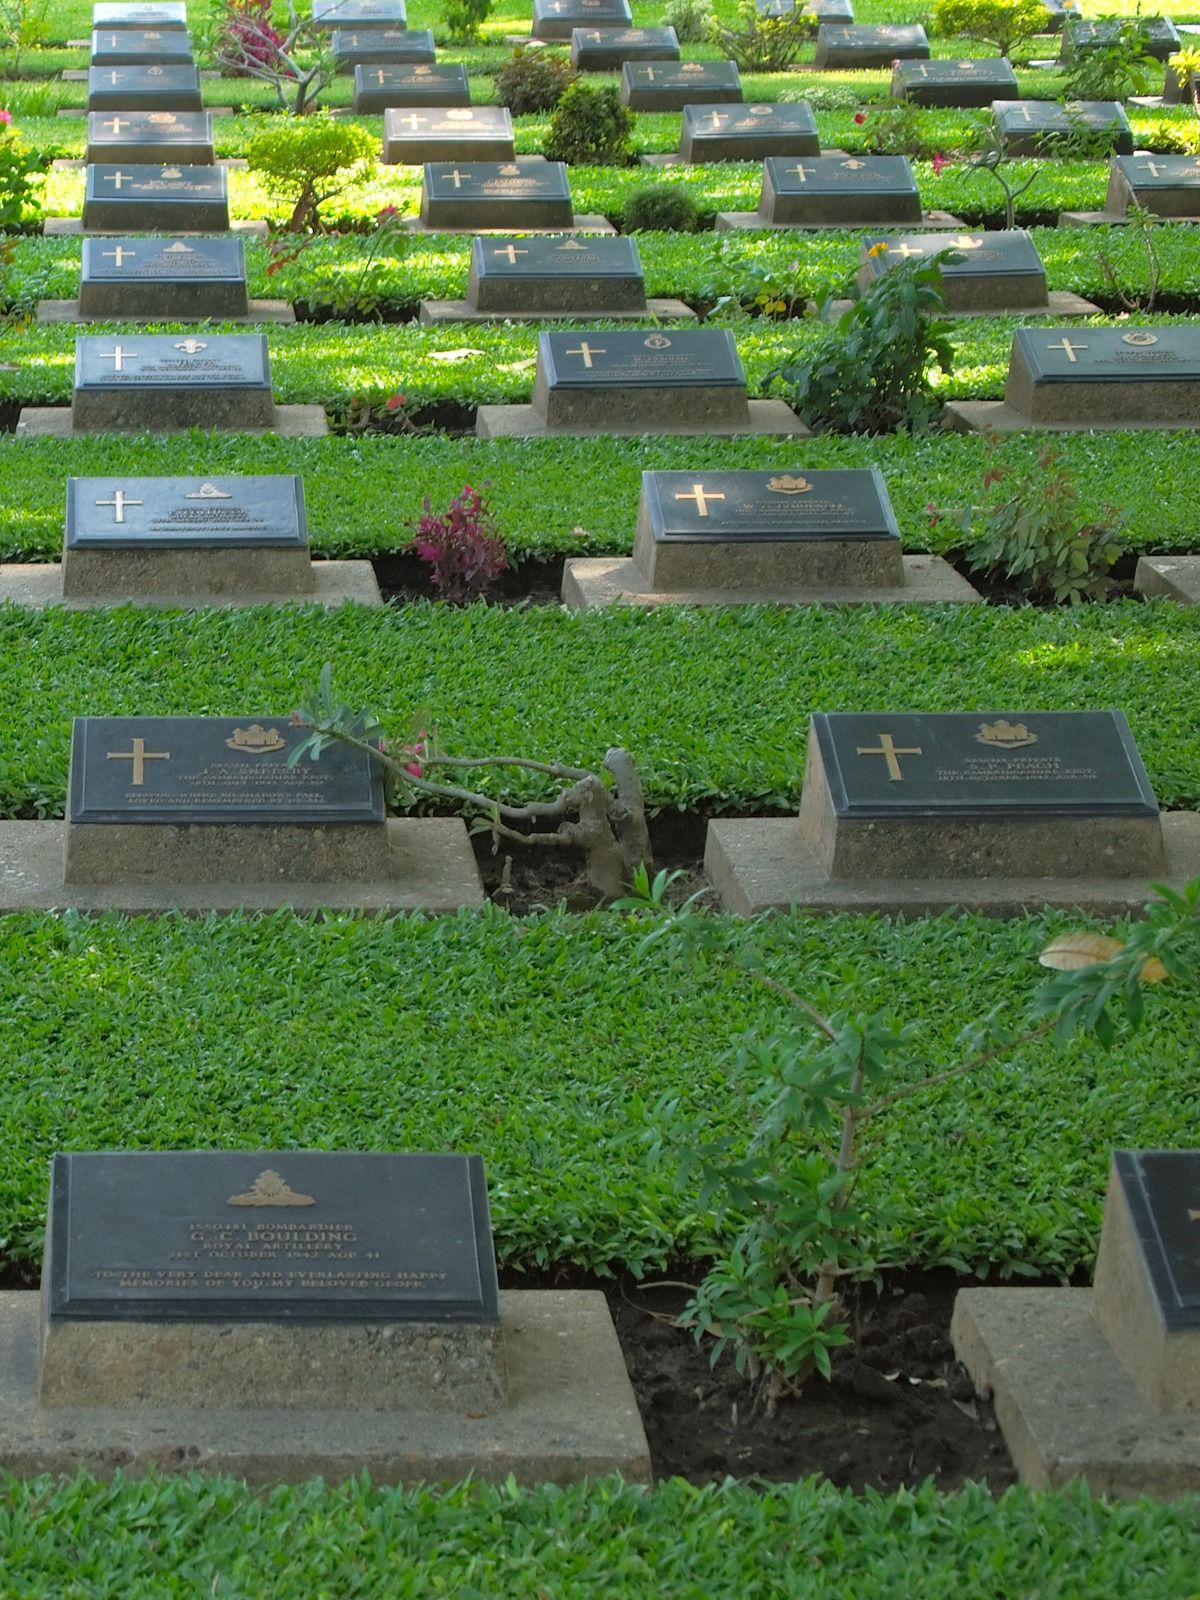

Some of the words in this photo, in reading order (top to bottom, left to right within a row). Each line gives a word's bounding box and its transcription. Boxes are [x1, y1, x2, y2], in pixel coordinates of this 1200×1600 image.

[256, 1223, 353, 1231] BOMBARDIER
[247, 1231, 357, 1242] BOULDING
[203, 1242, 250, 1250] ROYAL
[262, 1242, 344, 1250] ARTILLERY
[208, 1251, 276, 1259] OCTOBER
[328, 1251, 357, 1259] AGE
[93, 1271, 113, 1279] TO
[288, 1271, 390, 1279] EVERLASTING
[397, 1271, 448, 1280] HAPPY
[119, 1279, 198, 1287] MEMORIES
[205, 1279, 225, 1287] OF
[271, 1279, 294, 1287] MY
[301, 1279, 368, 1288] BELOVED
